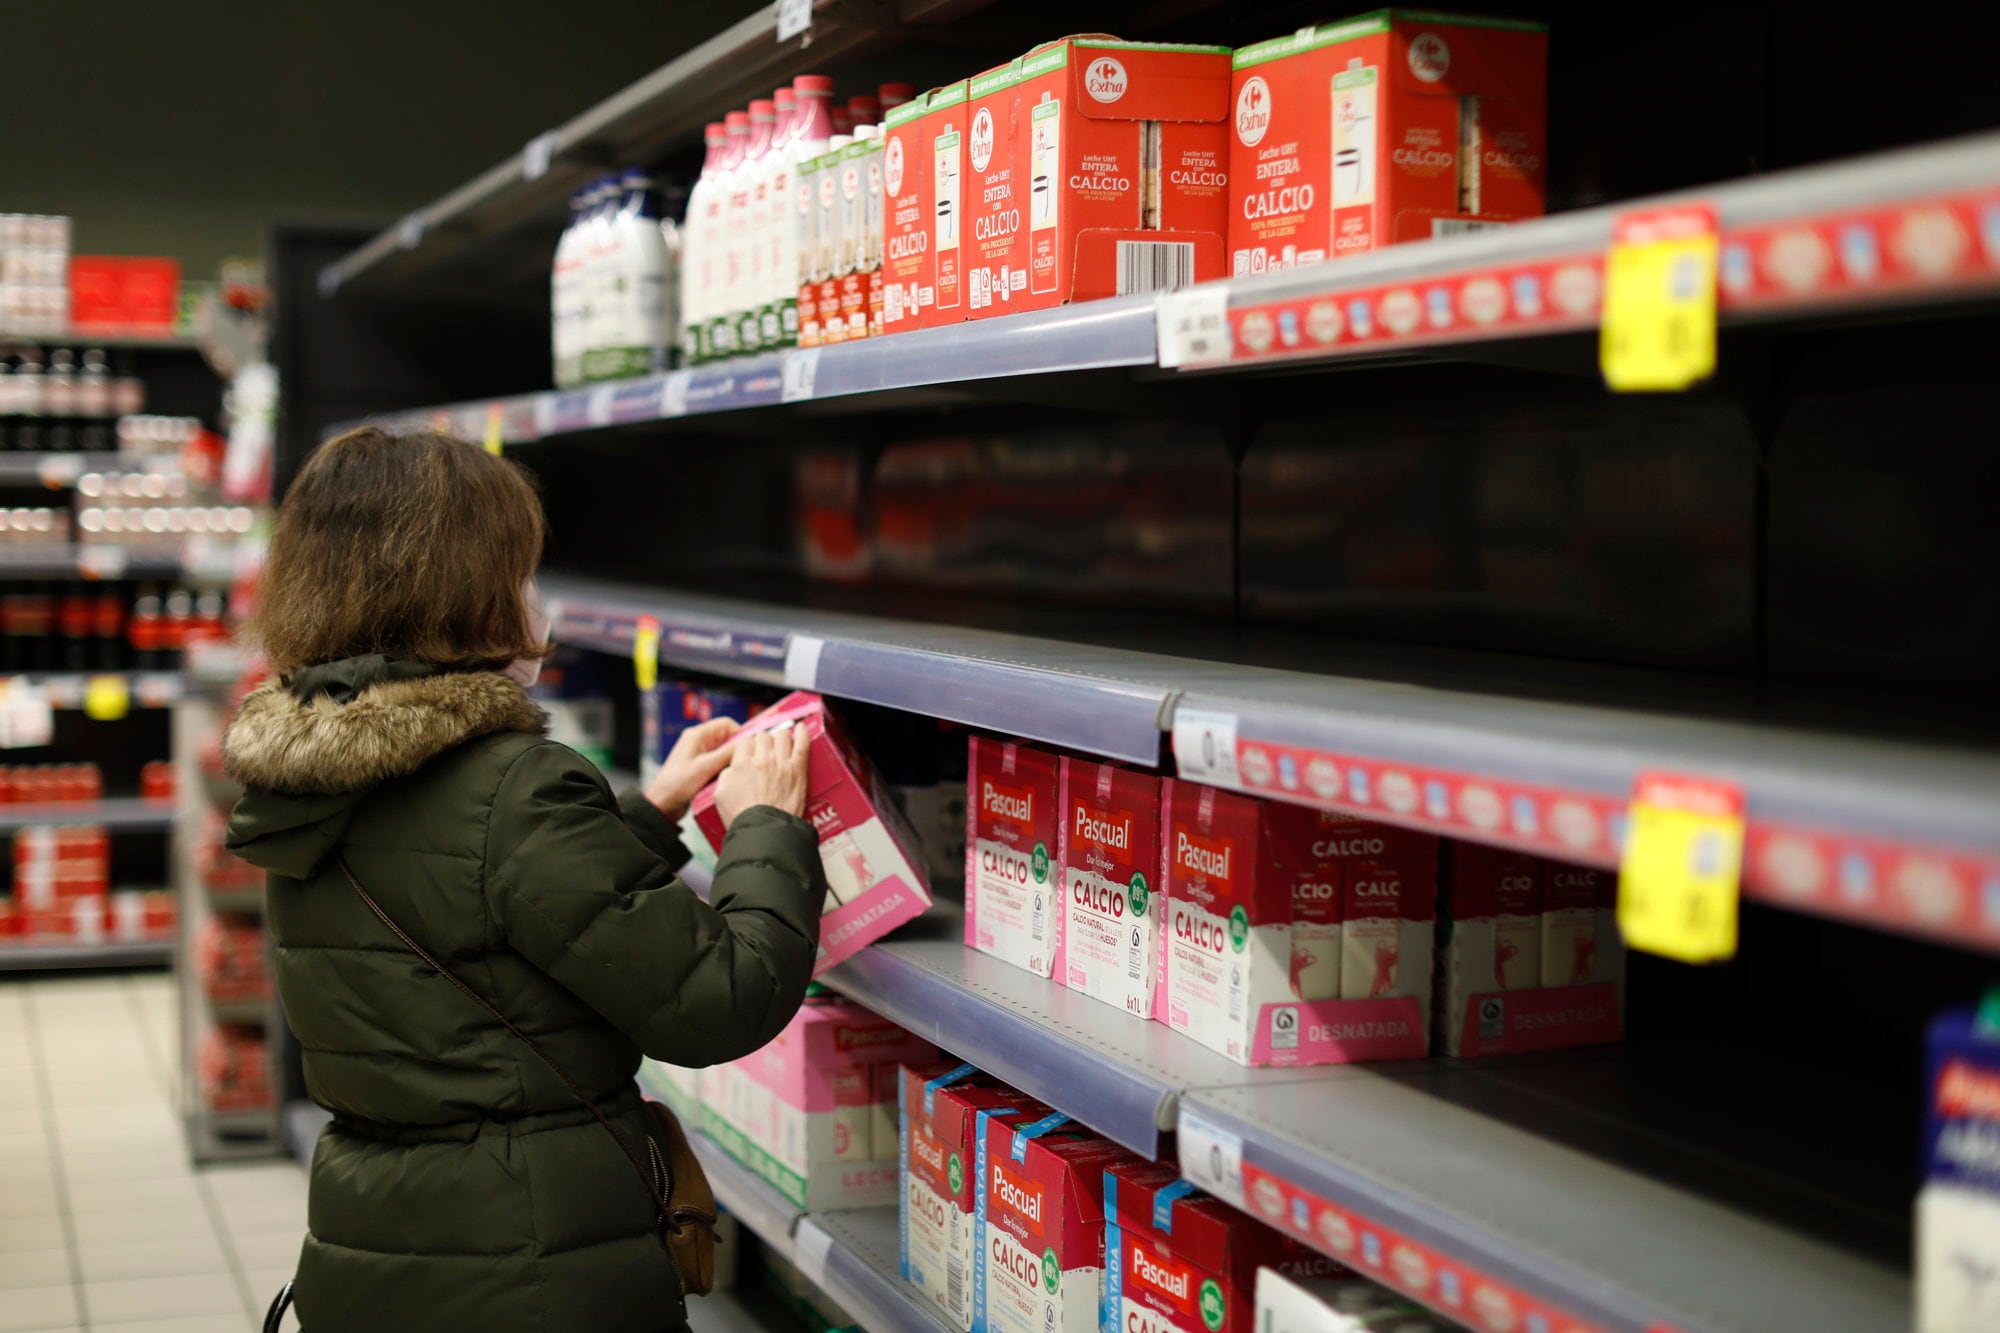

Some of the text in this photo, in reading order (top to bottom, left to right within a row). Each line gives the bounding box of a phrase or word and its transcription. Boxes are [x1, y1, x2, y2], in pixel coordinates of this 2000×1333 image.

[1089, 78, 1123, 93] Extra
[1239, 112, 1267, 134] Extra
[972, 139, 991, 160] Extra
[1181, 157, 1217, 168] ENTERA
[1259, 141, 1298, 160] Leche UHT
[1392, 148, 1453, 168] CALCIO
[1081, 162, 1118, 172] ENTERA
[1170, 171, 1228, 187] CALCIO
[1256, 157, 1300, 180] ENTERA
[984, 184, 1011, 203] ENTERA
[1069, 175, 1130, 192] CALCIO
[1243, 184, 1315, 220] CALCIO
[975, 208, 1019, 240] CALCIO
[889, 230, 928, 260] CALCIO
[1033, 256, 1054, 269] CALCIO
[983, 781, 1032, 822] Pascual
[1076, 806, 1129, 849] Pascual
[965, 793, 976, 913] DESNATADA
[1177, 831, 1231, 880] Pascual
[1312, 838, 1385, 858] CALCIO
[983, 849, 1028, 884] CALCIO
[1086, 853, 1095, 864] Dar
[1100, 858, 1115, 873] mejor
[1056, 820, 1066, 947] DESNATADA
[1073, 879, 1124, 918] CALCIO
[827, 893, 905, 947] DESNATADA
[1072, 912, 1087, 925] CALCIO
[1087, 917, 1105, 932] NATURAL
[1157, 846, 1168, 984] DESNATADA
[1175, 911, 1224, 953] CALCIO
[1126, 994, 1141, 1013] 6x1L
[1308, 1021, 1409, 1042] DESNATADA
[912, 1129, 943, 1171] Pascual
[911, 1183, 944, 1229] CALCIO
[993, 1164, 1041, 1223] Pascual
[976, 1138, 986, 1320] SEMIDESNATADA
[1003, 1214, 1011, 1226] Dar
[1015, 1222, 1029, 1240] mejor
[992, 1237, 1038, 1288] CALCIO
[1133, 1246, 1189, 1300] Pascual
[1144, 1292, 1154, 1304] Dar
